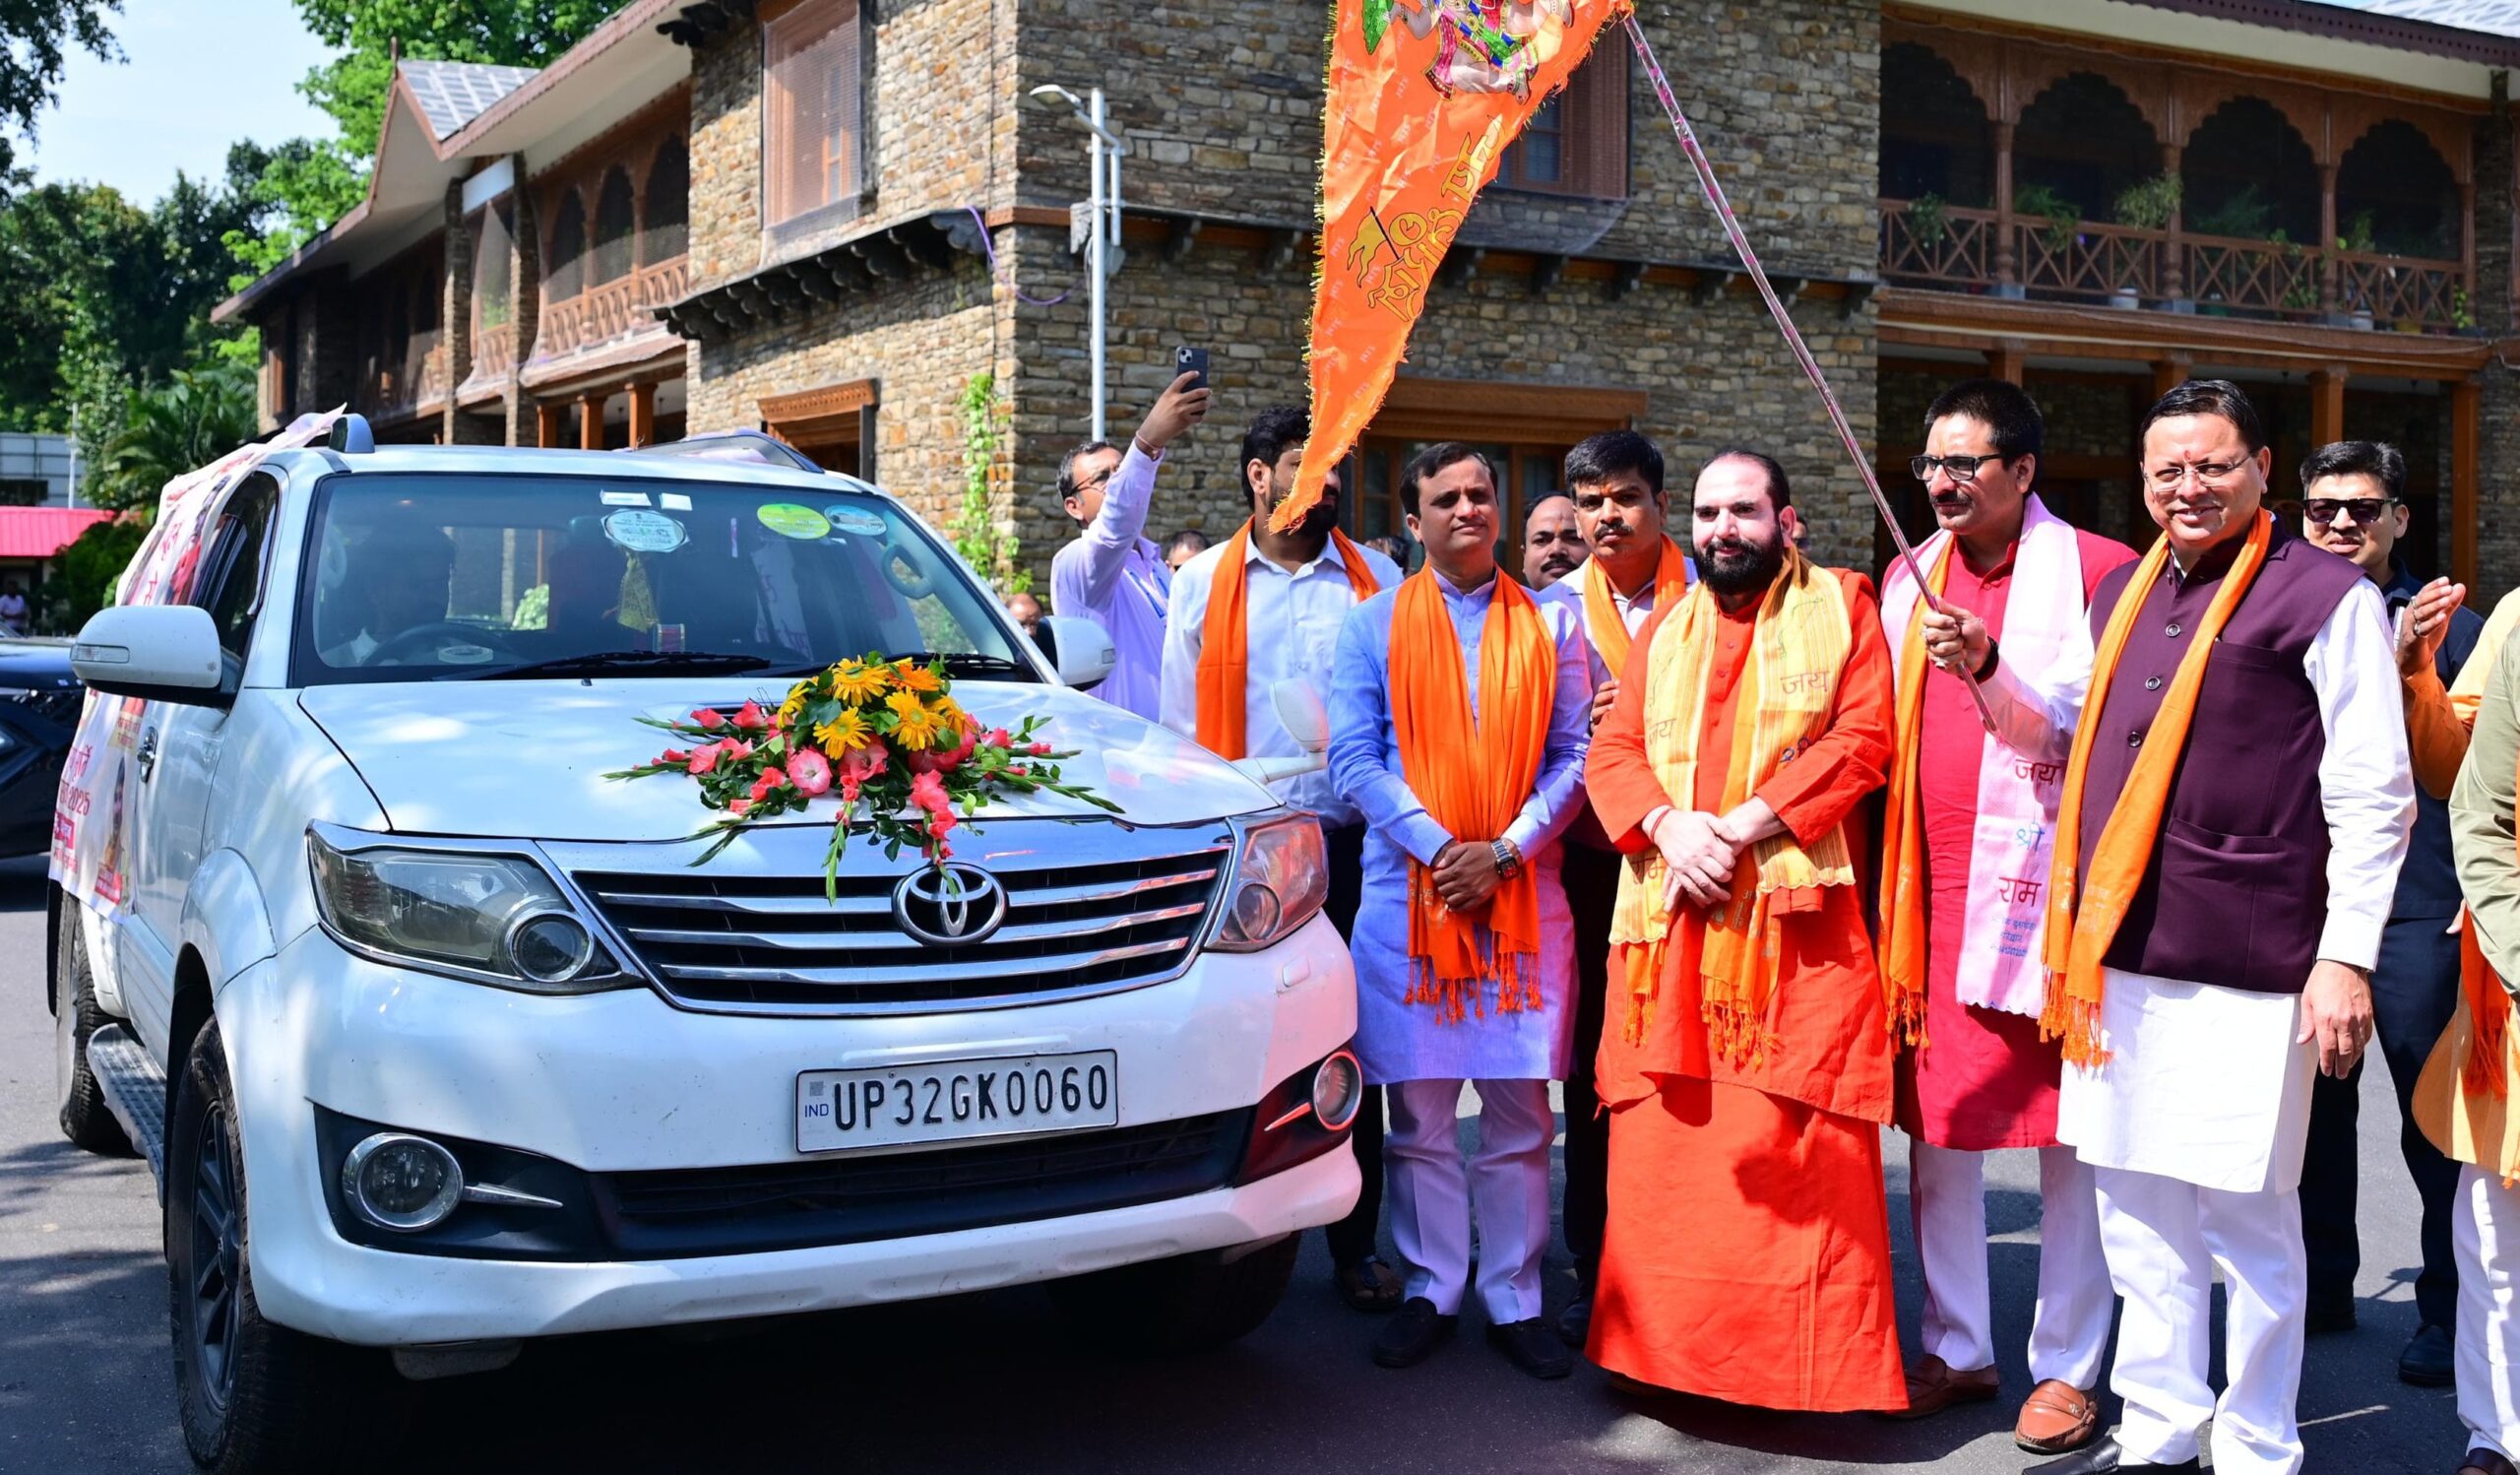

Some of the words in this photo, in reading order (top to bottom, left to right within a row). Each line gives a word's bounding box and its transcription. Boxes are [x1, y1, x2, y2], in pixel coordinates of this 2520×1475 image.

[1780, 671, 1831, 695] जय
[2015, 758, 2060, 785] जय
[2017, 821, 2045, 852] श्री
[1998, 875, 2043, 907] राम
[804, 1103, 829, 1119] IND
[835, 1064, 1107, 1130] UP32GK0060
